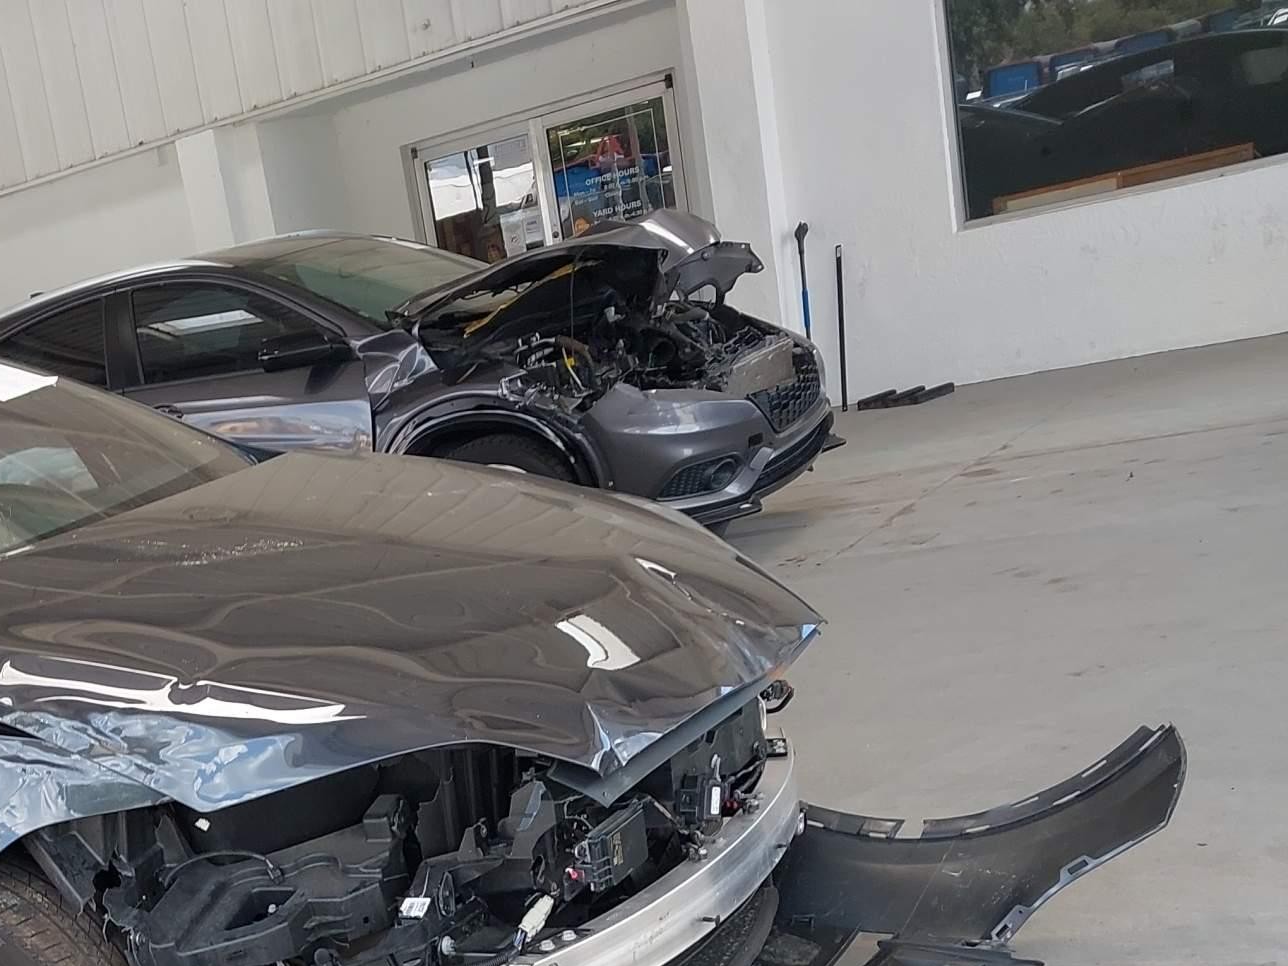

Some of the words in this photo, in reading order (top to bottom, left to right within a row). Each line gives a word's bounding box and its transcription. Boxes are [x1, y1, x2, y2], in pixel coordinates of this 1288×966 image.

[585, 172, 612, 186] OFFICE
[613, 166, 640, 180] HOURS
[593, 207, 614, 218] YARD
[614, 199, 642, 213] HOURS
